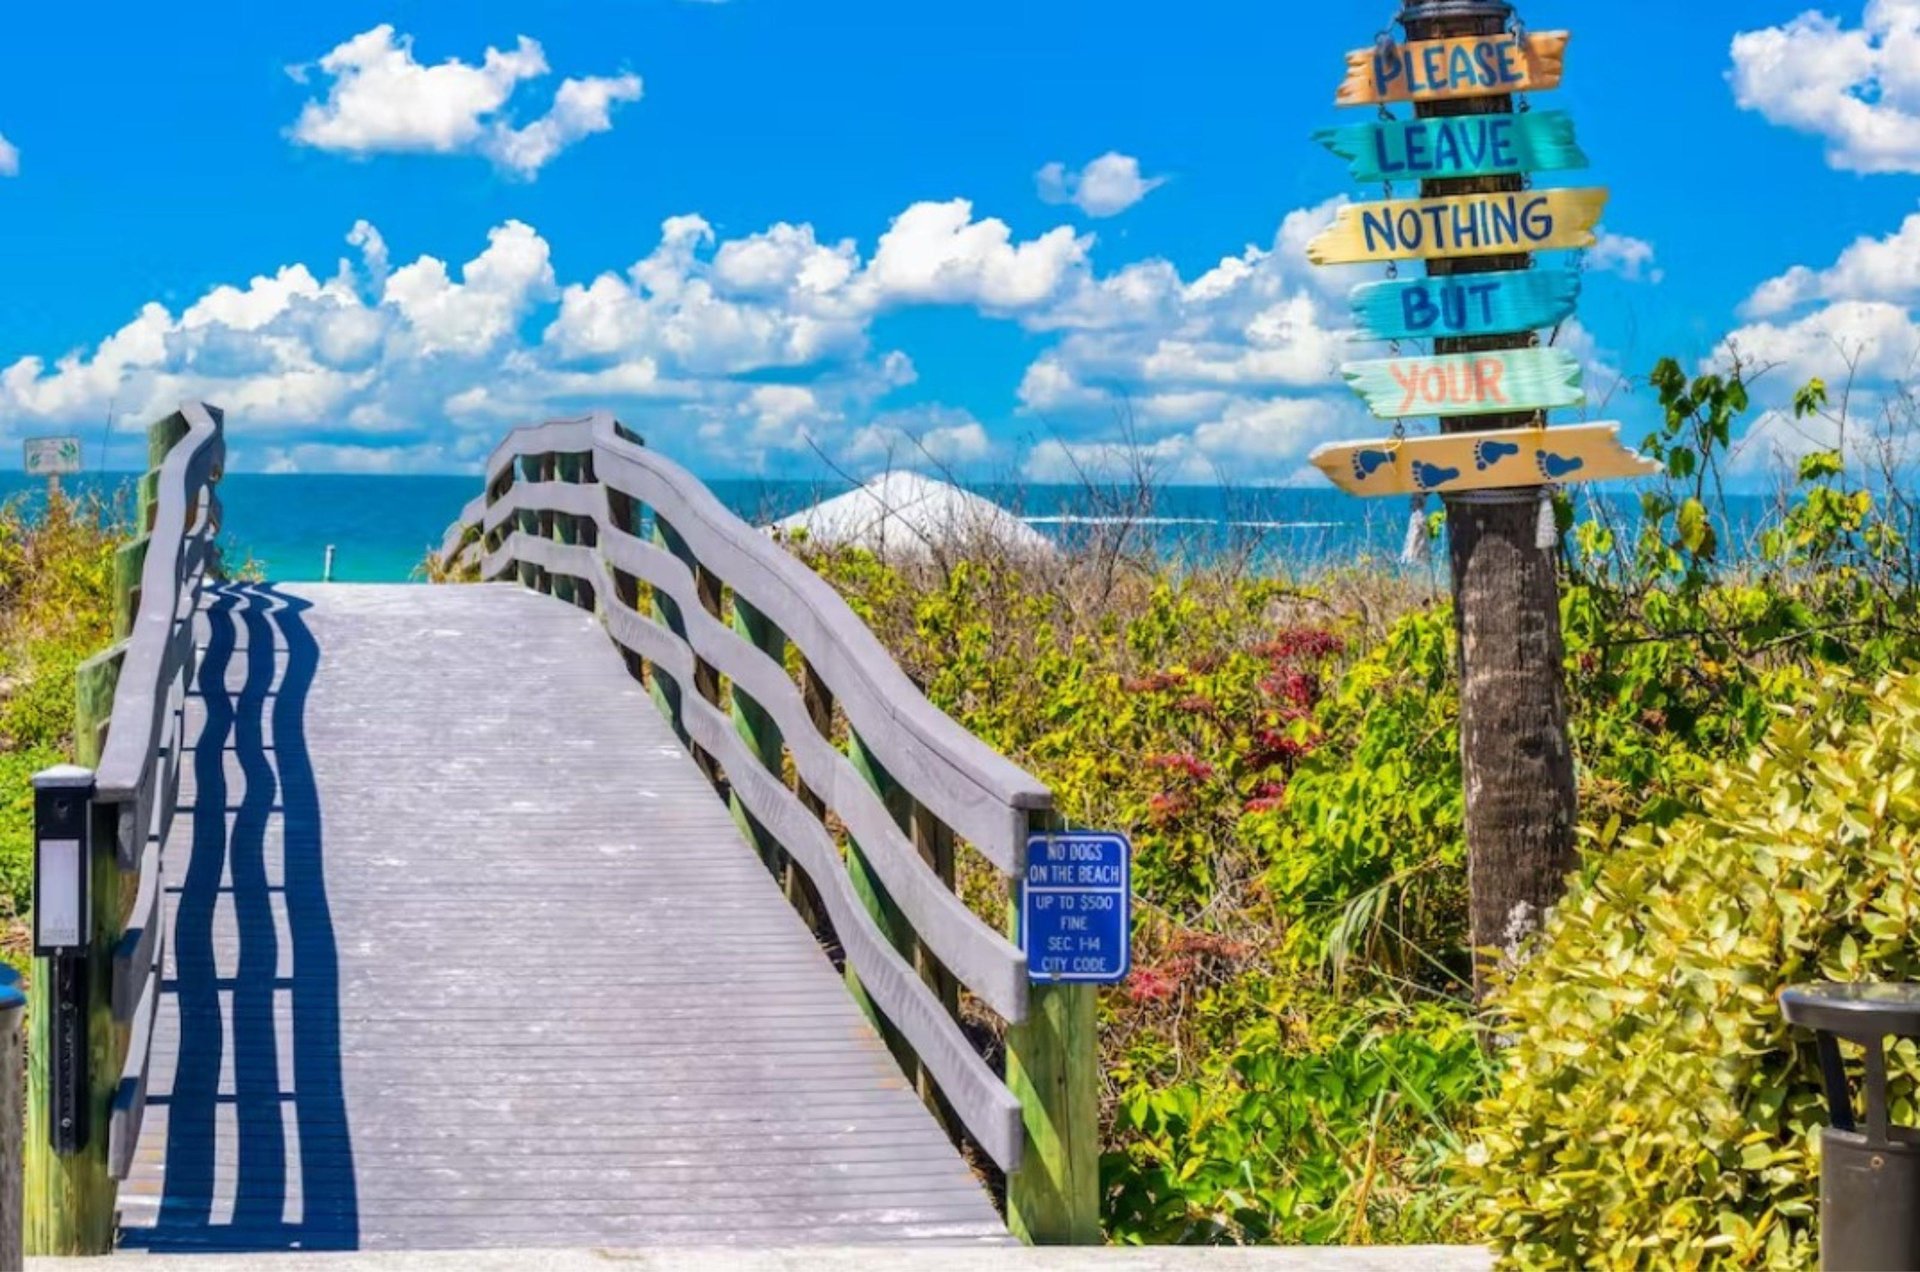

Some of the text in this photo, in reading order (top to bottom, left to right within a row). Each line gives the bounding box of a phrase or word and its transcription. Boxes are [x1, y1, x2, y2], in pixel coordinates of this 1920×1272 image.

[1373, 41, 1523, 95] PLEASE
[1376, 120, 1518, 172] LEAVE
[1362, 197, 1552, 251] NOTHING
[1400, 283, 1500, 331] BUT
[1389, 359, 1509, 412] YOUR
[1047, 844, 1103, 861] NO DOGS
[1030, 865, 1119, 883] ON THE BEACH
[1035, 895, 1113, 911] UP TO $500
[1060, 917, 1087, 930] FINE
[1079, 936, 1100, 951] 1-14
[1041, 957, 1106, 971] CITY CODE
